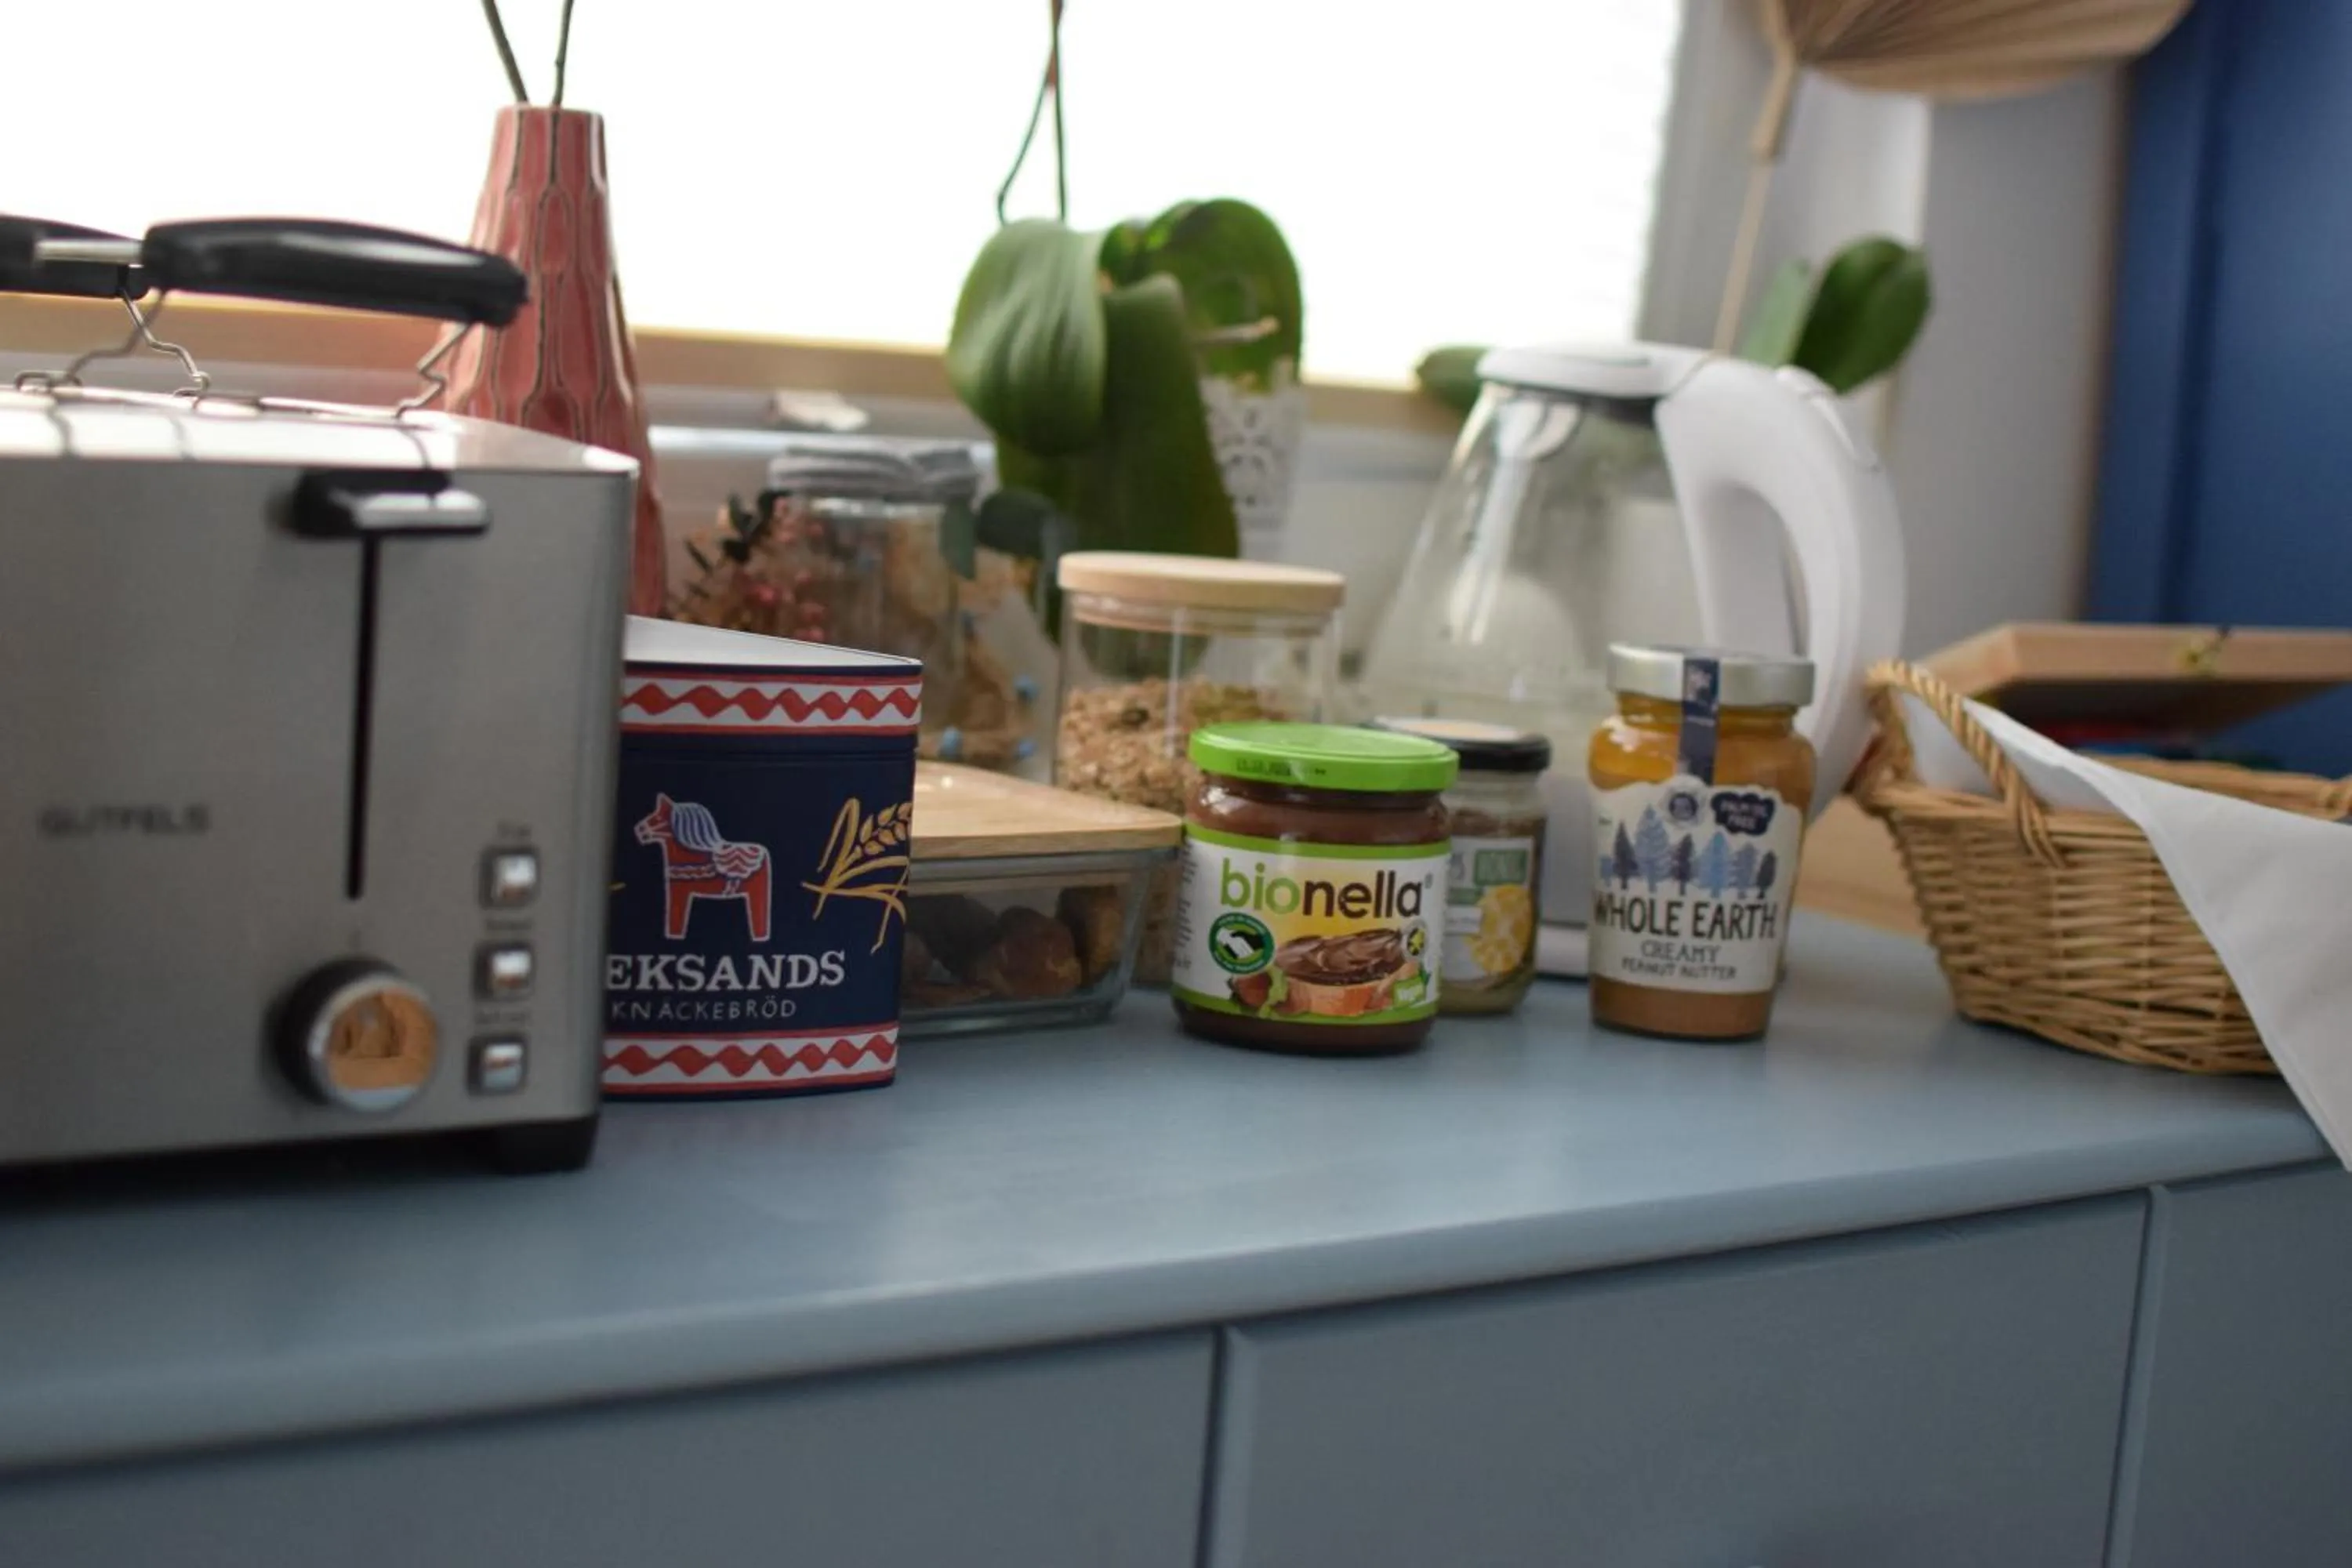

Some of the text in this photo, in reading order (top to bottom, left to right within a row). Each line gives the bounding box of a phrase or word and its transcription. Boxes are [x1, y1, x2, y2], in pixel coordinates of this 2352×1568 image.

[1221, 858, 1422, 919] bionella
[1595, 891, 1777, 941] WHOLE EARTH
[604, 950, 846, 992] EKSANDS
[1642, 940, 1722, 964] CREAMY
